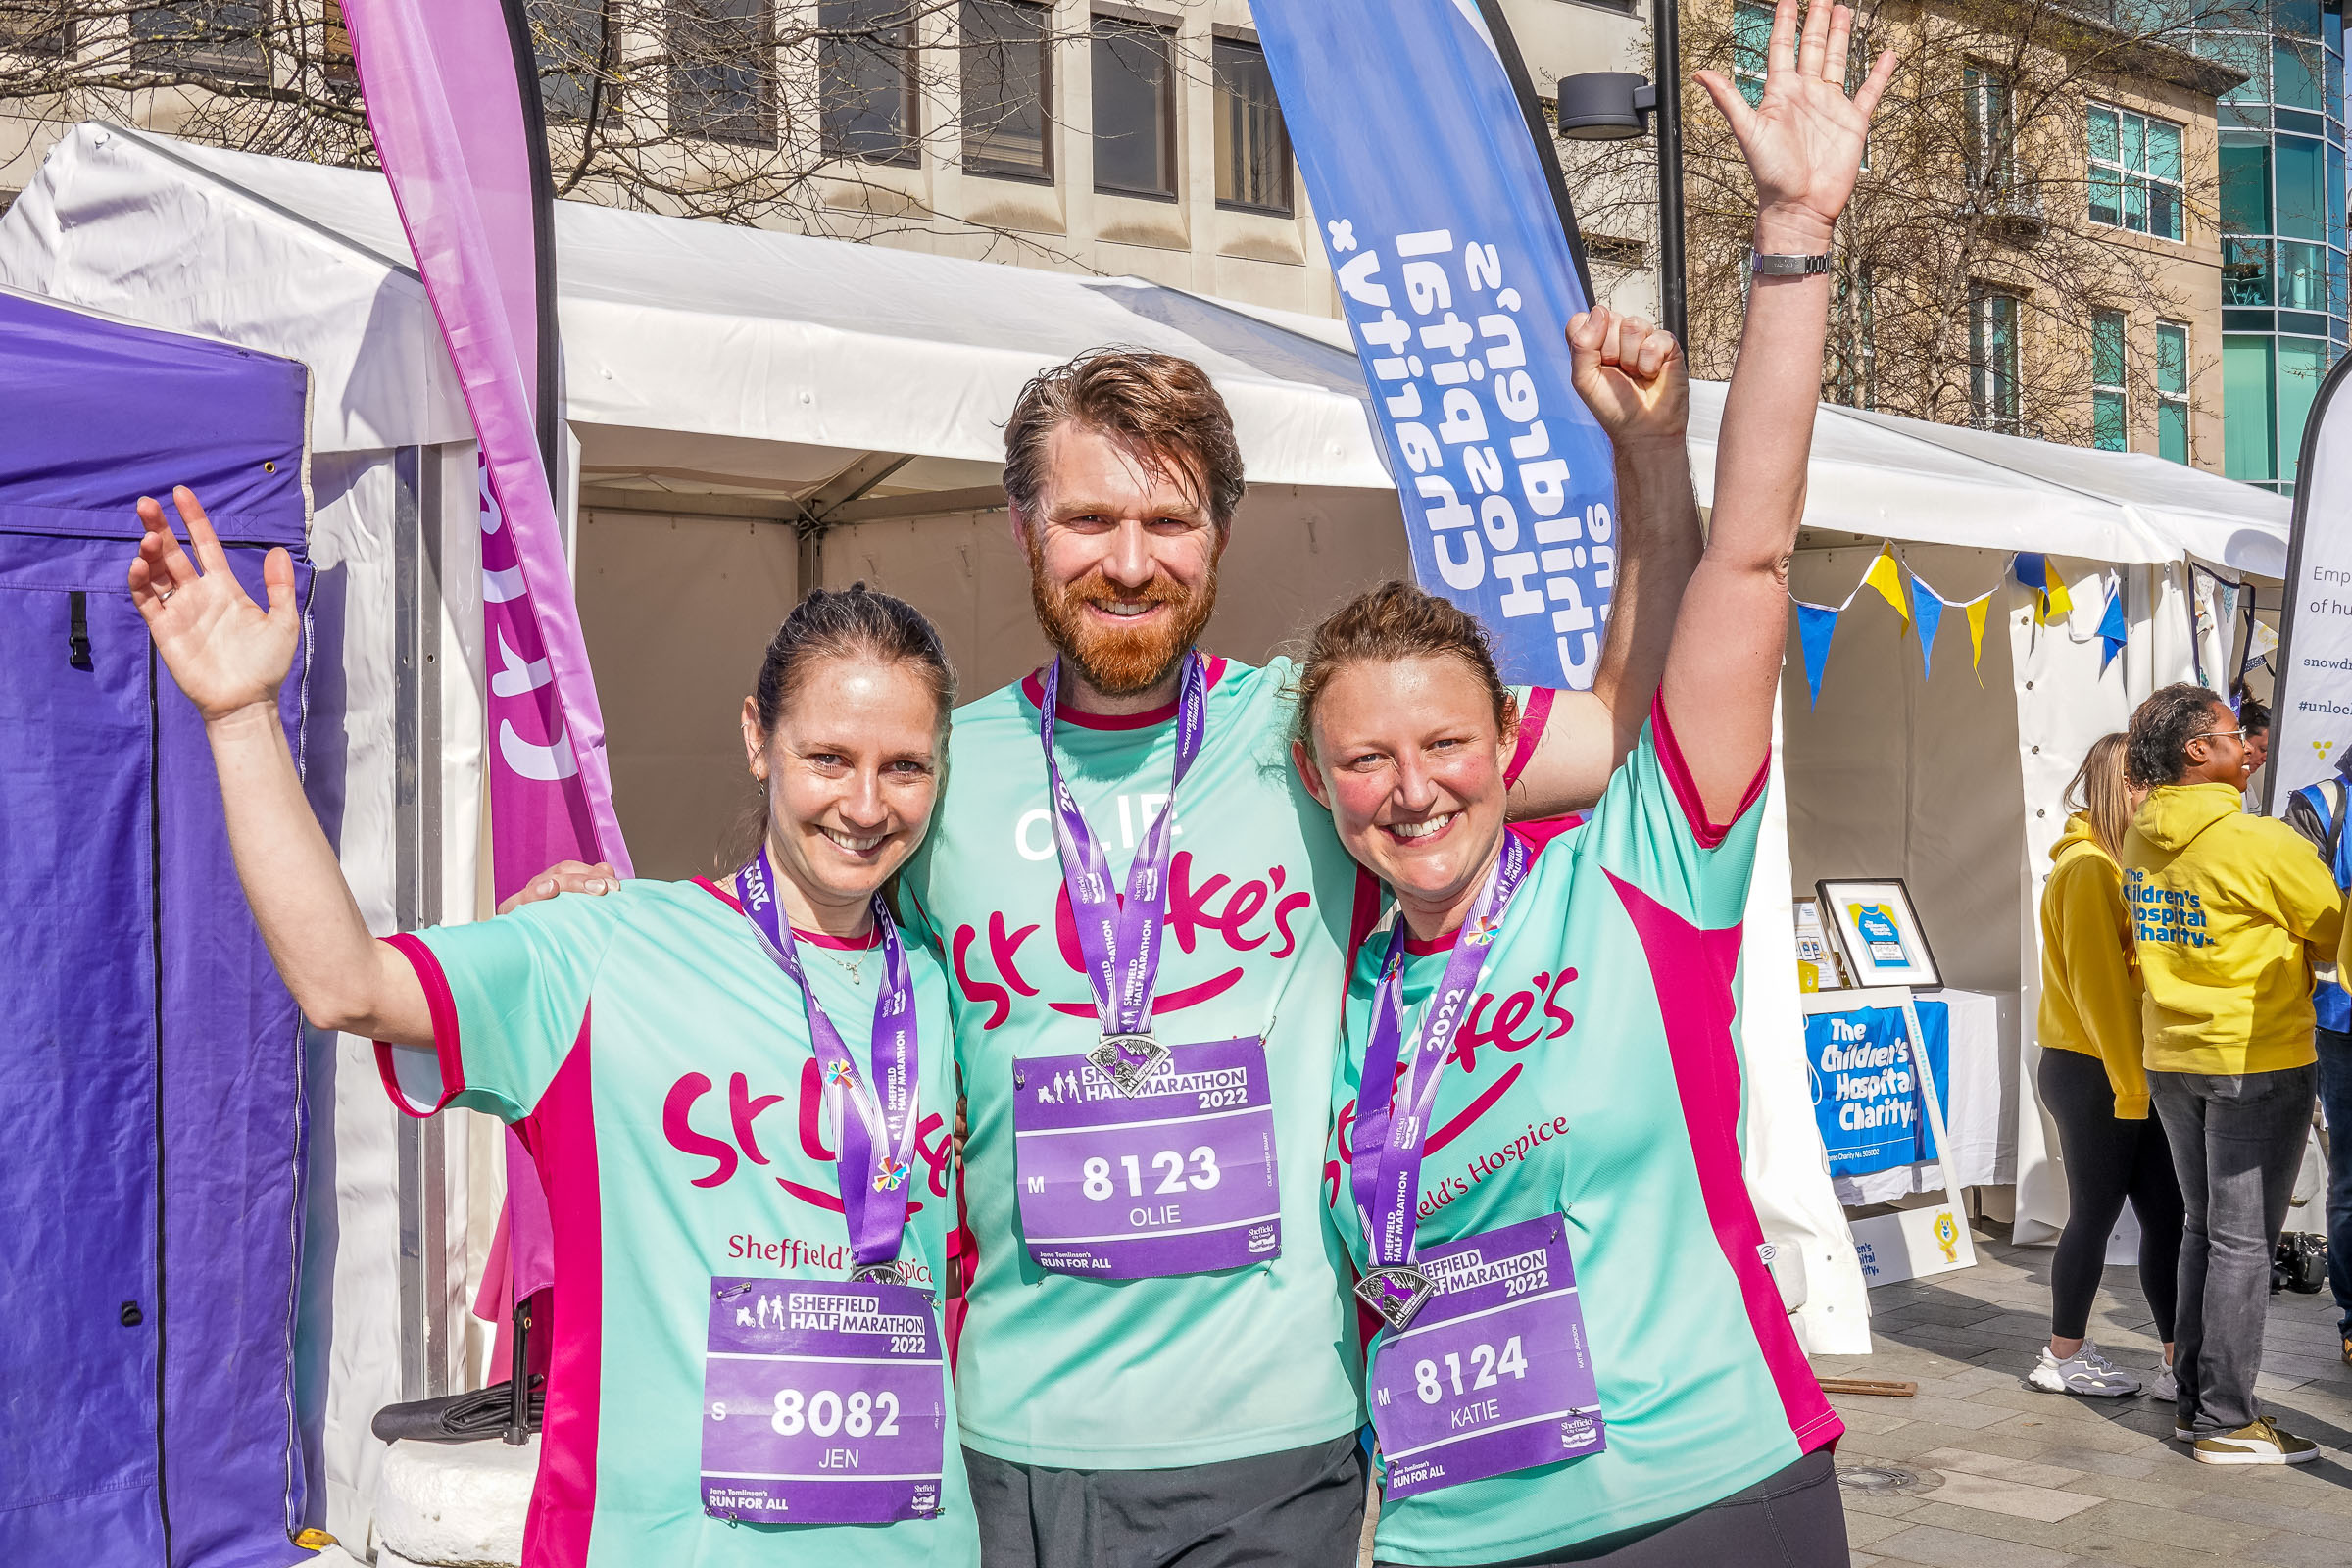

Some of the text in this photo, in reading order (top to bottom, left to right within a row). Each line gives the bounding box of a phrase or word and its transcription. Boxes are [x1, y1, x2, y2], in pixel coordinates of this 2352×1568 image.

[2310, 599, 2328, 613] of
[1055, 851, 1311, 974] Lke's
[1133, 920, 1152, 1006] HALF MARATHON
[1124, 959, 1137, 1006] SHEFFIELD
[1426, 988, 1465, 1053] 2022
[1831, 1018, 1866, 1041] The
[896, 1030, 906, 1110] HALF MARATHON
[1836, 1064, 1915, 1102] Hospital
[888, 1067, 897, 1111] SHEFFIELD
[1086, 1084, 1124, 1102] HAL
[1137, 1069, 1245, 1095] MARATHON
[1199, 1088, 1248, 1109] 2022
[1839, 1098, 1912, 1131] Charity
[1468, 1116, 1570, 1183] Hospice
[1028, 1176, 1045, 1193] M
[1082, 1146, 1221, 1201] 8123
[1129, 1204, 1181, 1227] OLIE
[1394, 1171, 1408, 1262] HALF MARATHON
[1384, 1211, 1396, 1262] SHEFFIELD
[728, 1234, 853, 1270] Sheffield'
[1041, 1258, 1112, 1268] RUN FOR ALL
[1421, 1252, 1479, 1277] EFFIELD
[1450, 1251, 1545, 1292] MARATHON
[1505, 1269, 1549, 1298] 2022
[791, 1295, 877, 1313] SHEFFIELD
[790, 1314, 924, 1333] HALF MARATHON
[890, 1336, 926, 1353] 2022
[1414, 1335, 1529, 1405] 8124
[710, 1402, 727, 1421] S
[1377, 1387, 1391, 1406] M
[771, 1388, 900, 1438] 8082
[1450, 1398, 1500, 1429] KATIE
[1561, 1417, 1592, 1431] Sheffield
[818, 1448, 859, 1468] JEN
[1393, 1465, 1446, 1488] RUN FOR ALL
[709, 1495, 789, 1510] RUN FOR ALL
[727, 1488, 768, 1497] Tomlinson's
